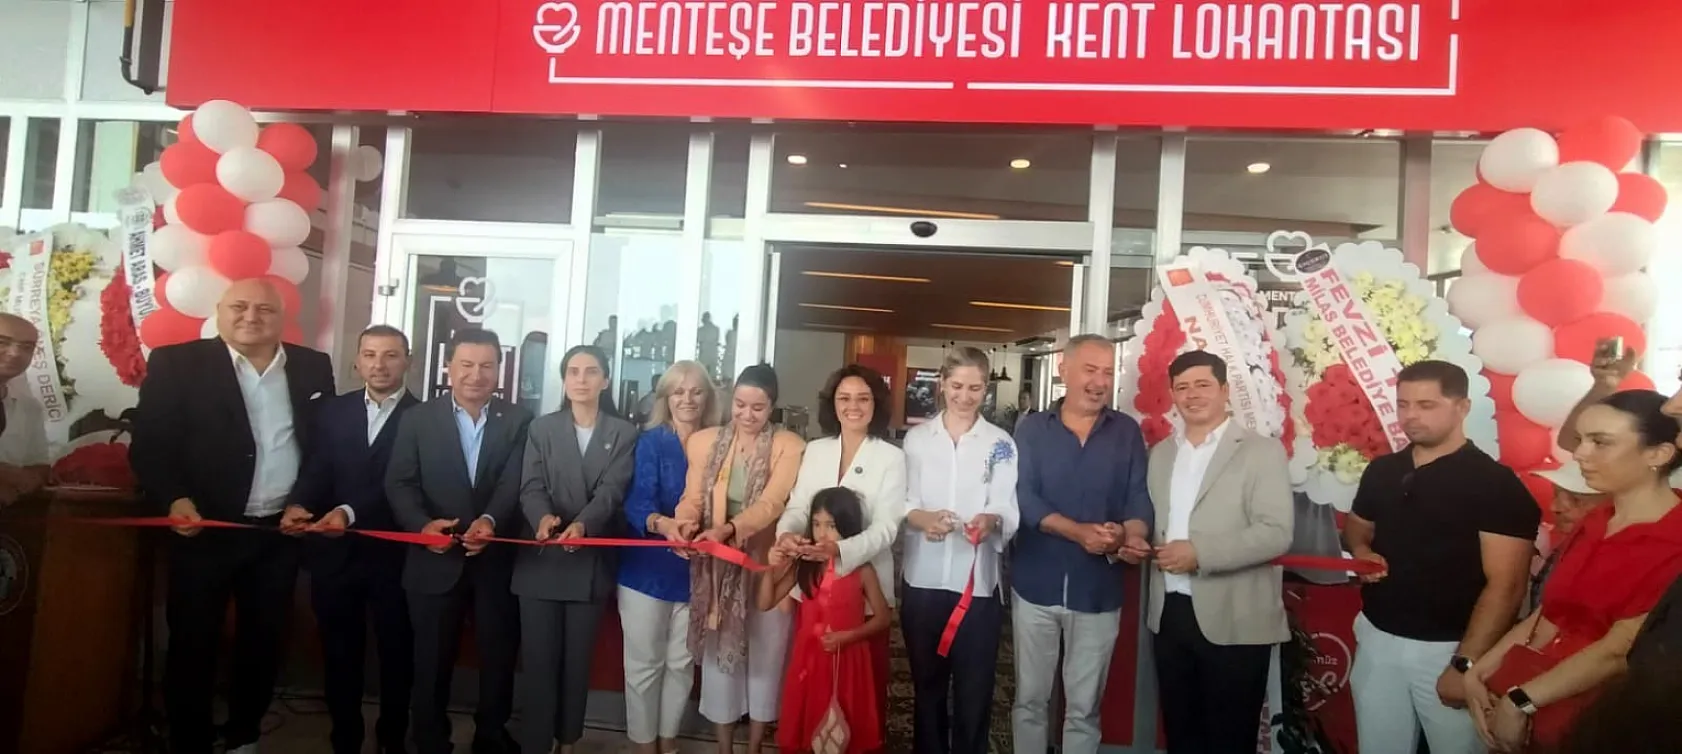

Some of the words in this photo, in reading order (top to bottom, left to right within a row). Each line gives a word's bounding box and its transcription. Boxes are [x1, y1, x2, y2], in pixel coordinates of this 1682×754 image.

[596, 2, 777, 60] MENTEŞE
[788, 0, 1021, 58] BELEDİYESİ
[1046, 3, 1155, 60] KENT
[1172, 3, 1420, 61] LOKANTASI
[1304, 276, 1338, 324] MİLAS
[1332, 324, 1395, 417] BELEDİYE
[1320, 267, 1389, 357] FEVZİ
